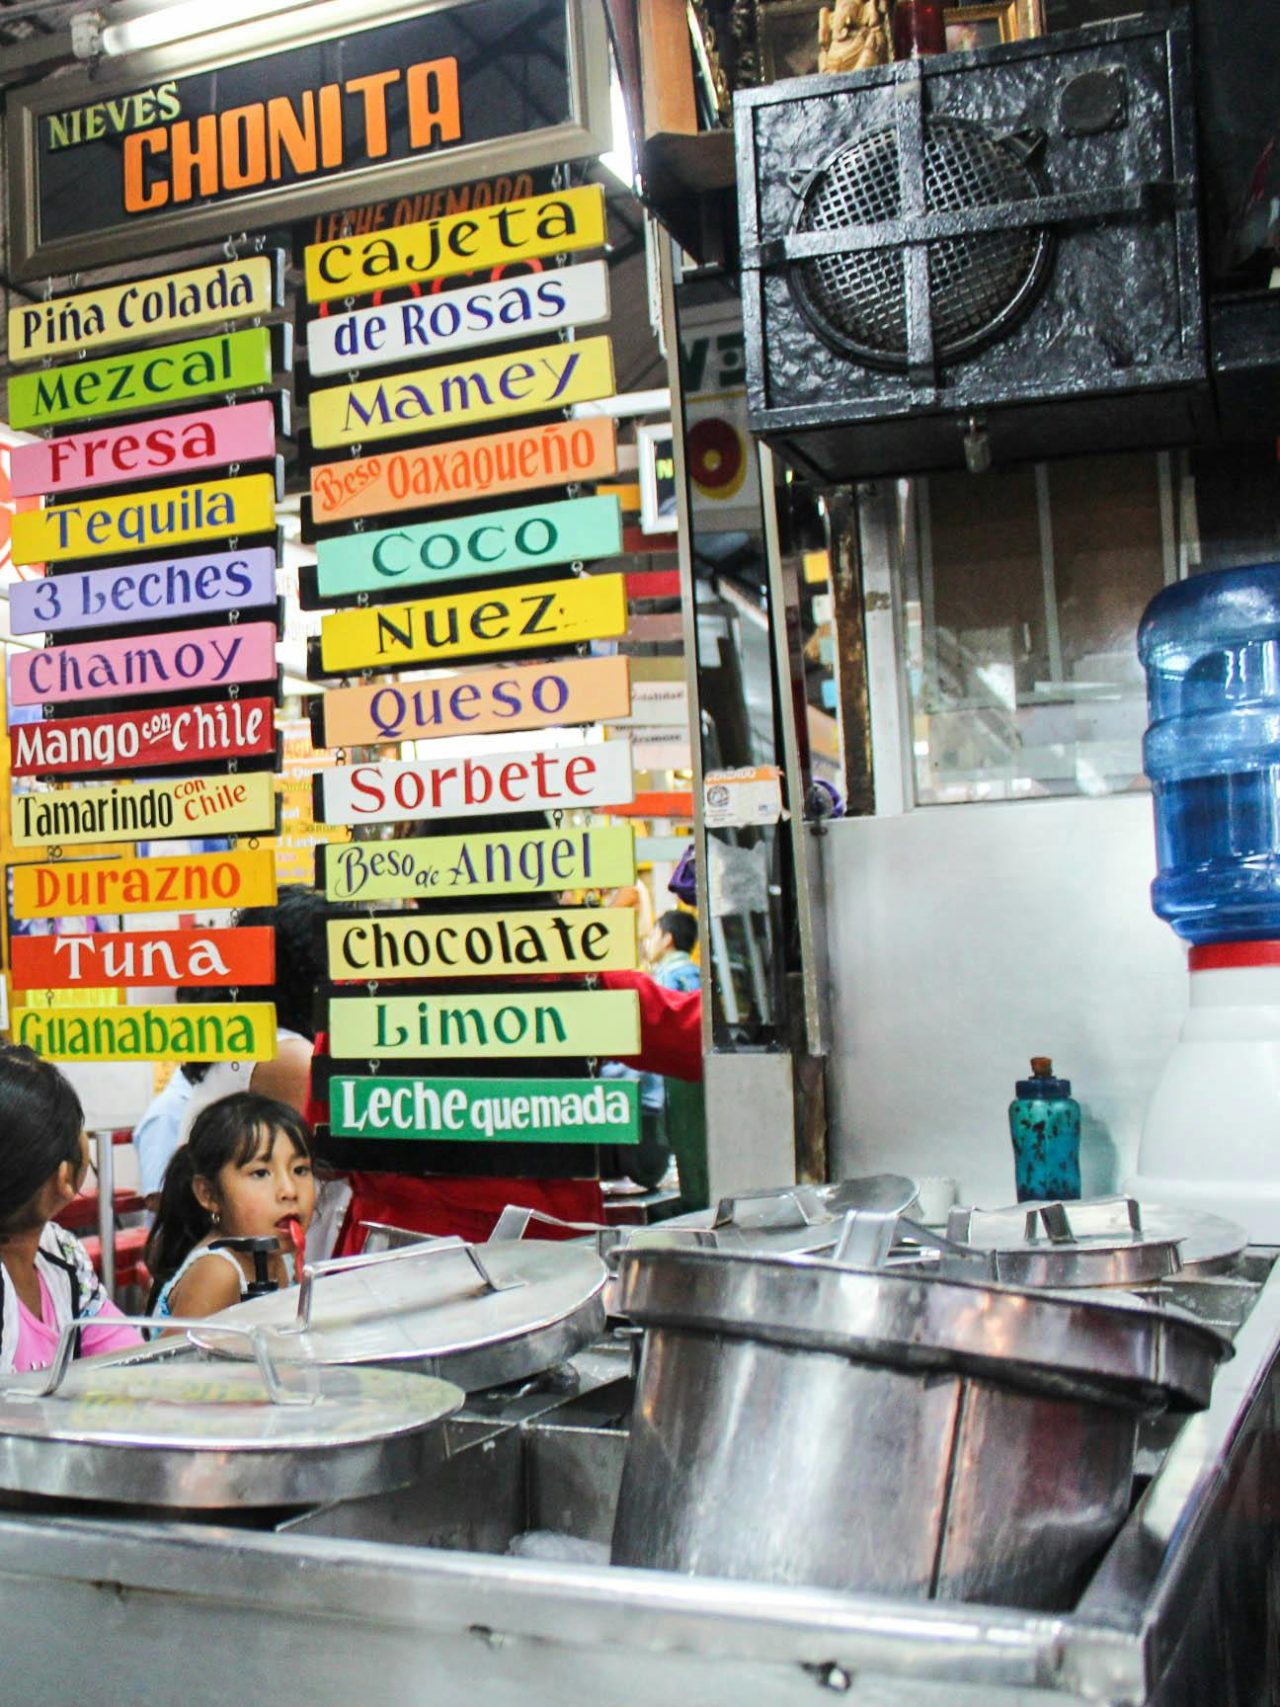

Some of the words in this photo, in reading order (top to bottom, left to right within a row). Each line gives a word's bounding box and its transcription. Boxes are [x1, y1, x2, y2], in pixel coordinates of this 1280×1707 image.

[47, 82, 181, 150] NIEVES
[124, 56, 462, 213] CHONITA
[118, 268, 254, 329] Colada
[334, 313, 387, 356] de
[401, 280, 567, 346] Rosas
[32, 338, 232, 417] Mezcal
[342, 352, 581, 432] Mamey
[47, 420, 217, 483] Fresa
[313, 458, 382, 511] Beso
[387, 426, 596, 501] Oaxaqueño
[45, 488, 236, 549] Tequila
[33, 581, 62, 621] 3
[81, 560, 253, 616] Leches
[376, 593, 558, 654] Nuez
[29, 636, 244, 695] Chamoy
[14, 720, 140, 768] Mango
[142, 711, 172, 742] con
[172, 702, 264, 752] Chile
[370, 675, 570, 739] Queso
[18, 788, 174, 838] Tamarindo
[174, 779, 207, 801] con
[184, 783, 248, 821] Chile
[350, 752, 597, 814] Sorbete
[33, 862, 242, 909] Durazno
[334, 845, 416, 898] Beso
[415, 864, 440, 889] de
[449, 832, 592, 888] Angel
[53, 935, 232, 980] Tuna
[19, 1010, 256, 1057] Guanabana
[373, 1001, 568, 1048] Limon
[340, 1080, 468, 1132] Leche
[471, 1085, 631, 1138] quemada
